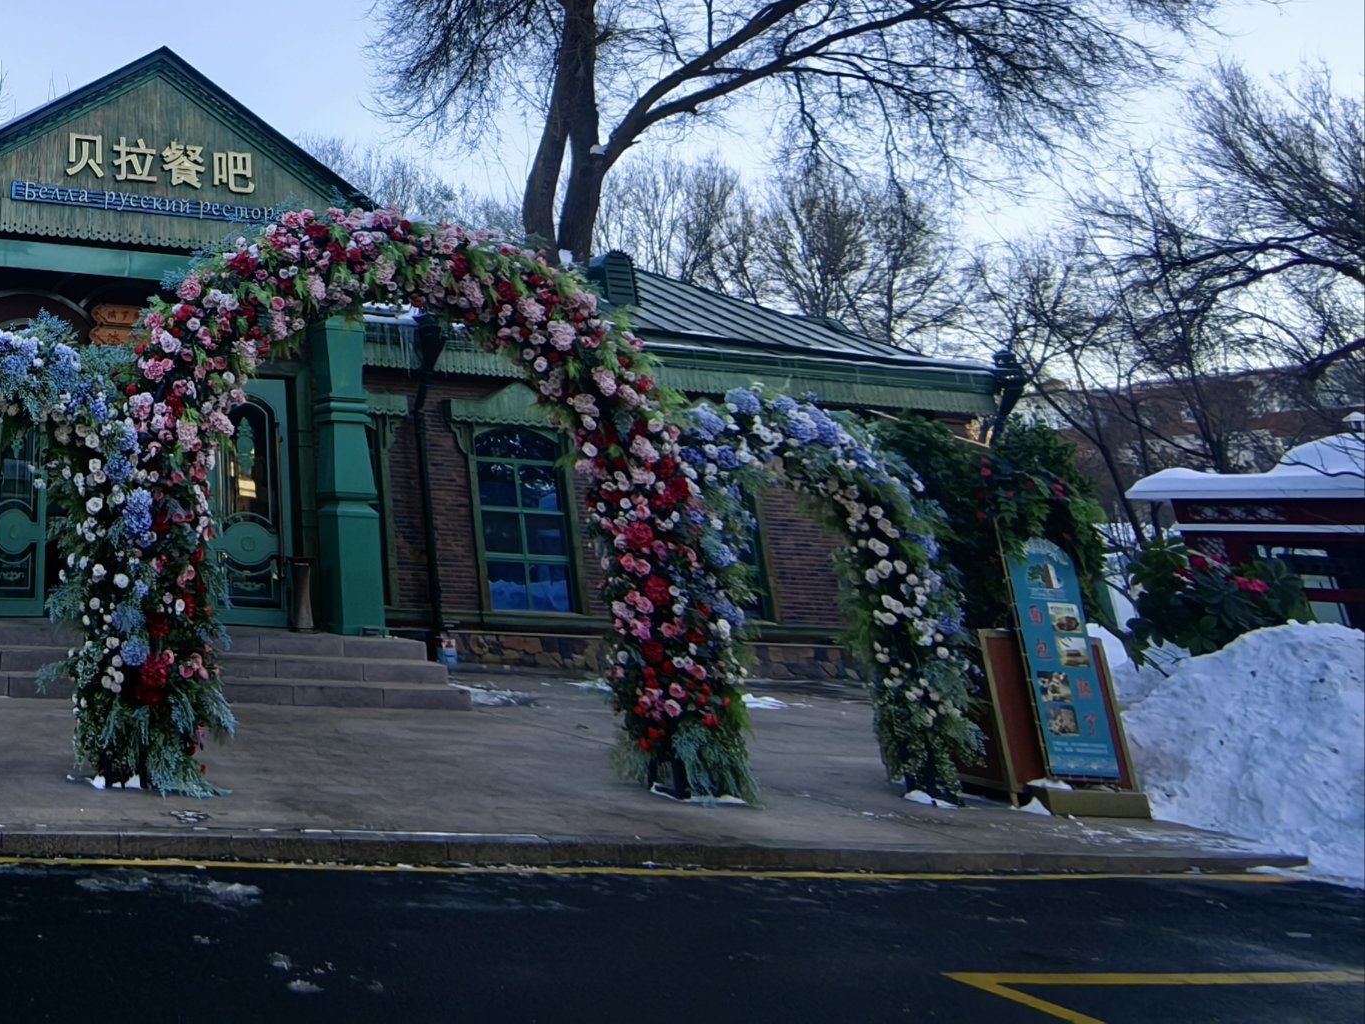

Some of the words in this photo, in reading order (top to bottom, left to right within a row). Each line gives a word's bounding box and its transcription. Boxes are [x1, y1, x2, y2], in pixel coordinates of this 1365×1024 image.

[66, 132, 255, 194] 贝拉餐吧
[25, 181, 89, 203] Белла
[104, 190, 190, 211] русский
